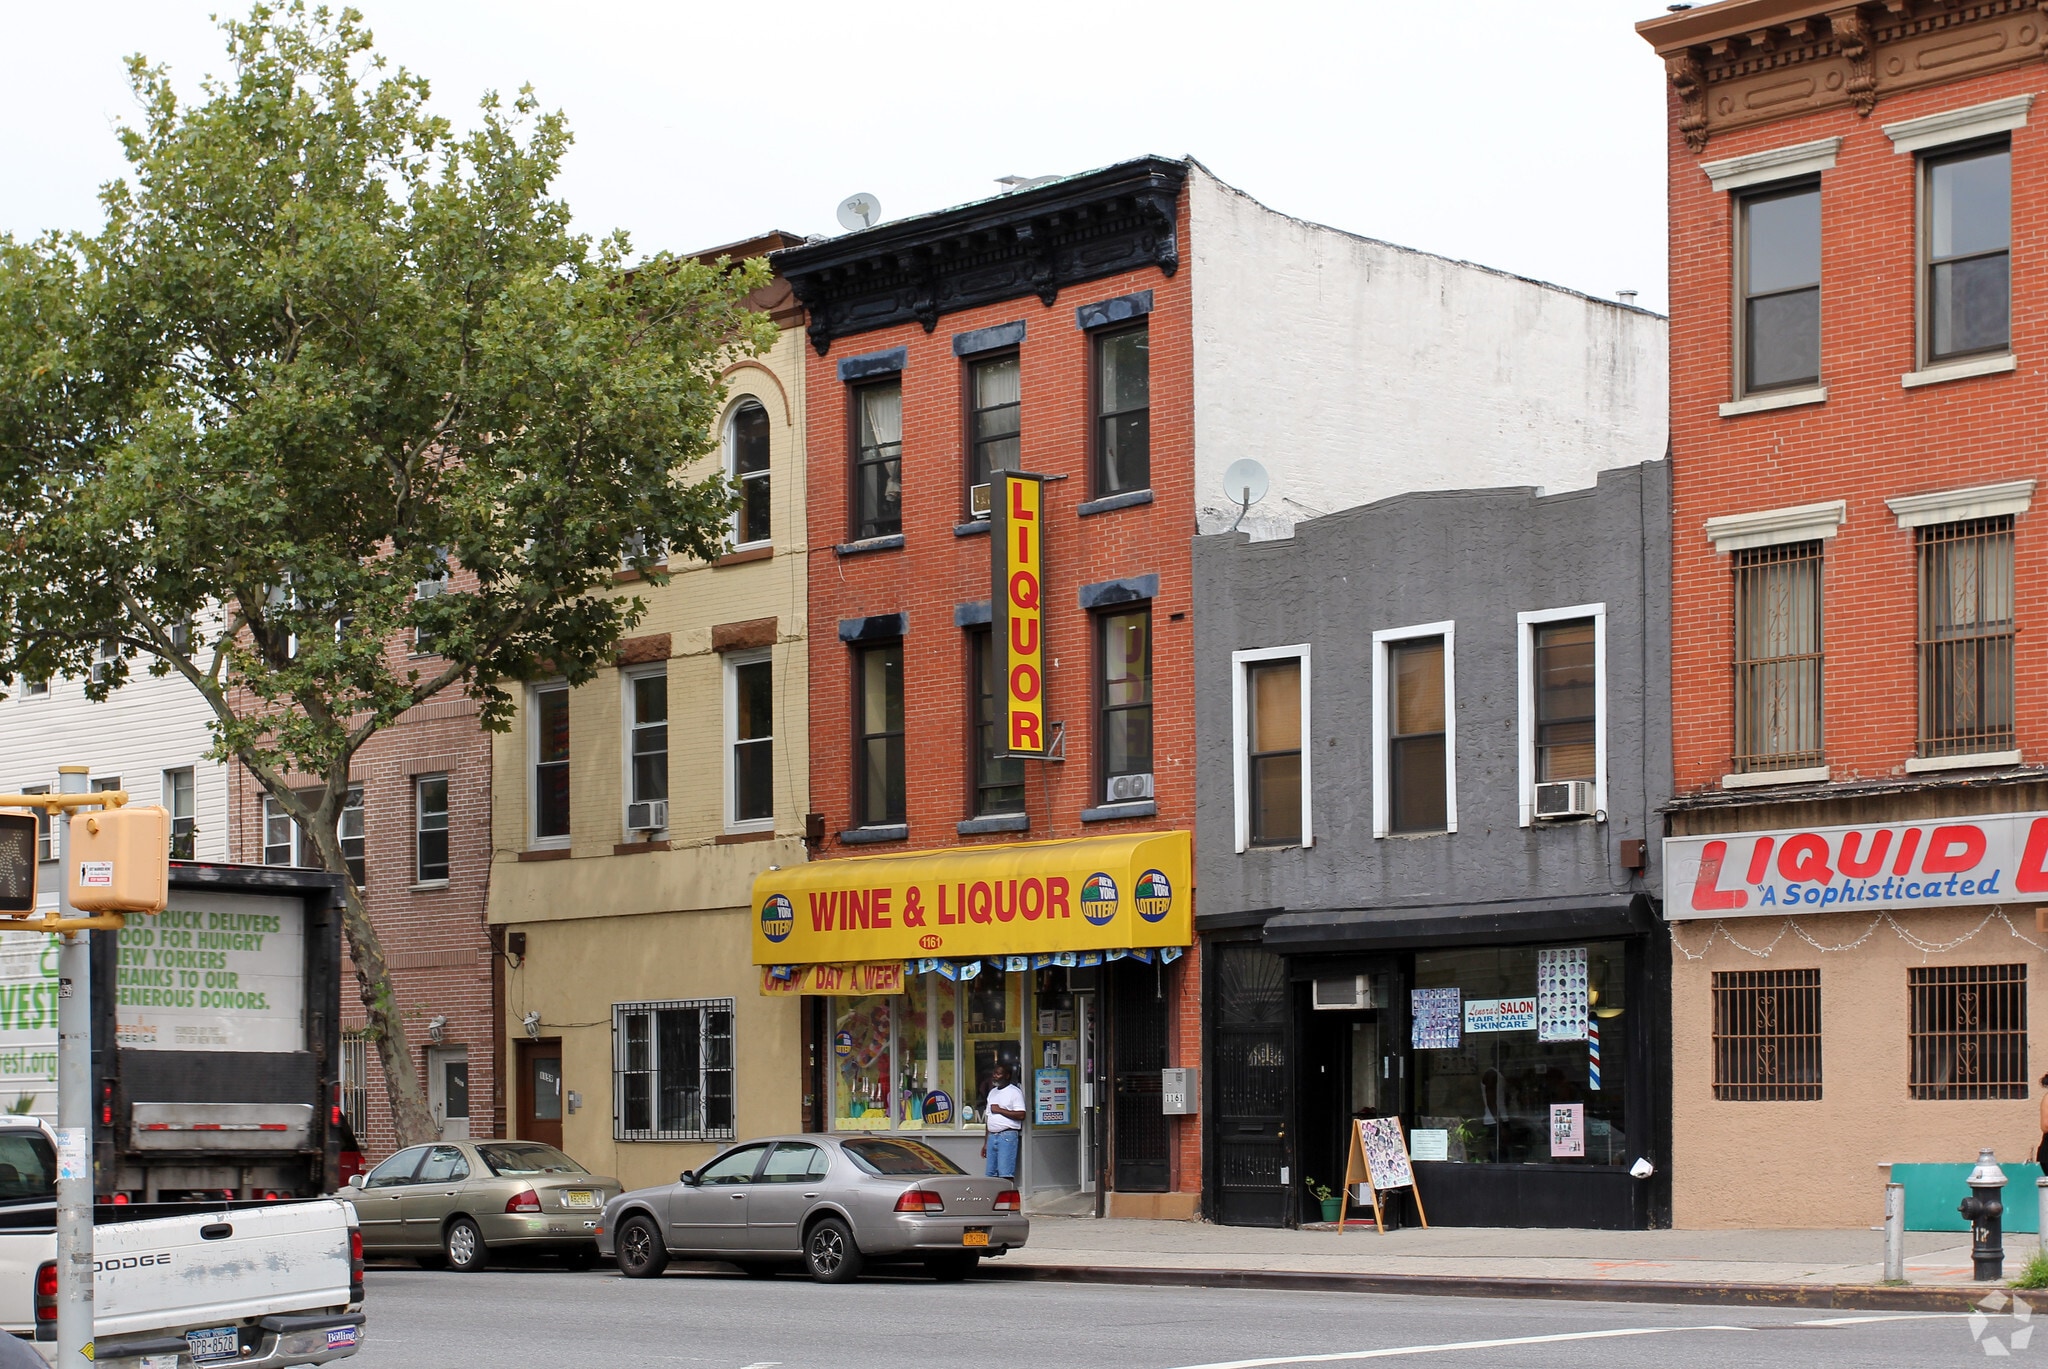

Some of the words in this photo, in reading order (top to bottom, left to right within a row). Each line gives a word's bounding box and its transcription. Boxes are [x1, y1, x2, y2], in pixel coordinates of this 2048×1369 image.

[1009, 482, 1041, 749] LIQUOR
[1691, 825, 1987, 911] LIQUID
[1098, 877, 1113, 887] NEW
[1152, 873, 1166, 884] NEW
[1099, 886, 1116, 900] YORK
[1153, 883, 1169, 897] YORK
[1783, 869, 2000, 908] Sophisticated
[809, 888, 892, 931] WINE
[903, 886, 927, 928] &
[938, 876, 1071, 925] LIQUOR
[1082, 901, 1118, 918] LOTTERY
[1136, 897, 1171, 915] LOTTERY
[125, 912, 145, 927] IS
[209, 912, 281, 933] DELIVERS
[118, 928, 155, 947] OOD
[160, 930, 193, 948] FOR
[198, 931, 264, 951] HUNGRY
[921, 936, 940, 948] 1161
[153, 949, 227, 969] YORKERS
[117, 968, 173, 987] HANKS
[179, 970, 199, 988] TO
[205, 971, 239, 989] OUR
[816, 964, 844, 990] DAY
[850, 965, 858, 990] A
[863, 964, 901, 990] WEEK
[200, 990, 271, 1010] DONORS.
[1500, 1001, 1533, 1015] SALON
[116, 1024, 157, 1034] EEDING
[1474, 1020, 1528, 1030] SKINCARE
[115, 1033, 157, 1043] MERICA
[1165, 1094, 1183, 1102] 1161
